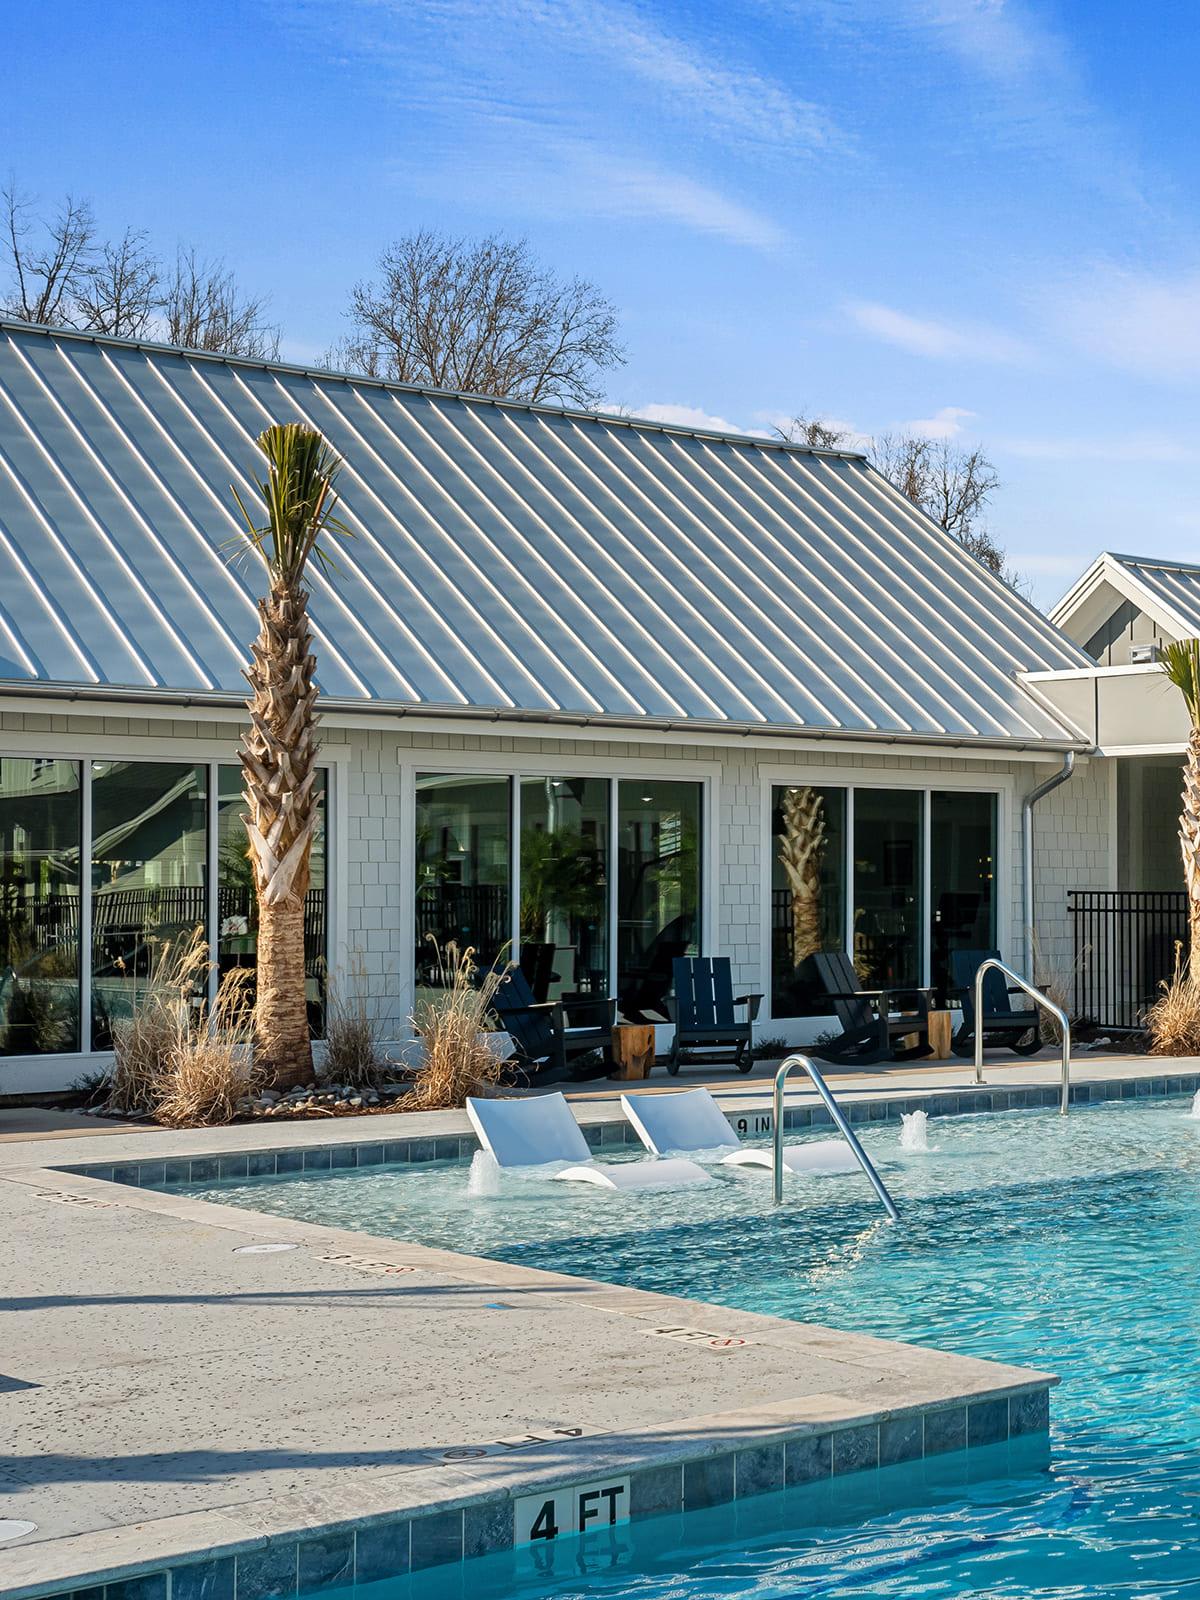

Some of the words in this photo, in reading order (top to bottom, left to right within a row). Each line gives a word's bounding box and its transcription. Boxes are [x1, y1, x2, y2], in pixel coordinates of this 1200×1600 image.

[737, 1118, 748, 1132] 9
[755, 1116, 770, 1132] IN
[671, 1331, 720, 1341] FT
[552, 1427, 582, 1437] 4
[495, 1435, 549, 1451] FT
[530, 1499, 559, 1540] 4
[579, 1485, 624, 1532] FT
